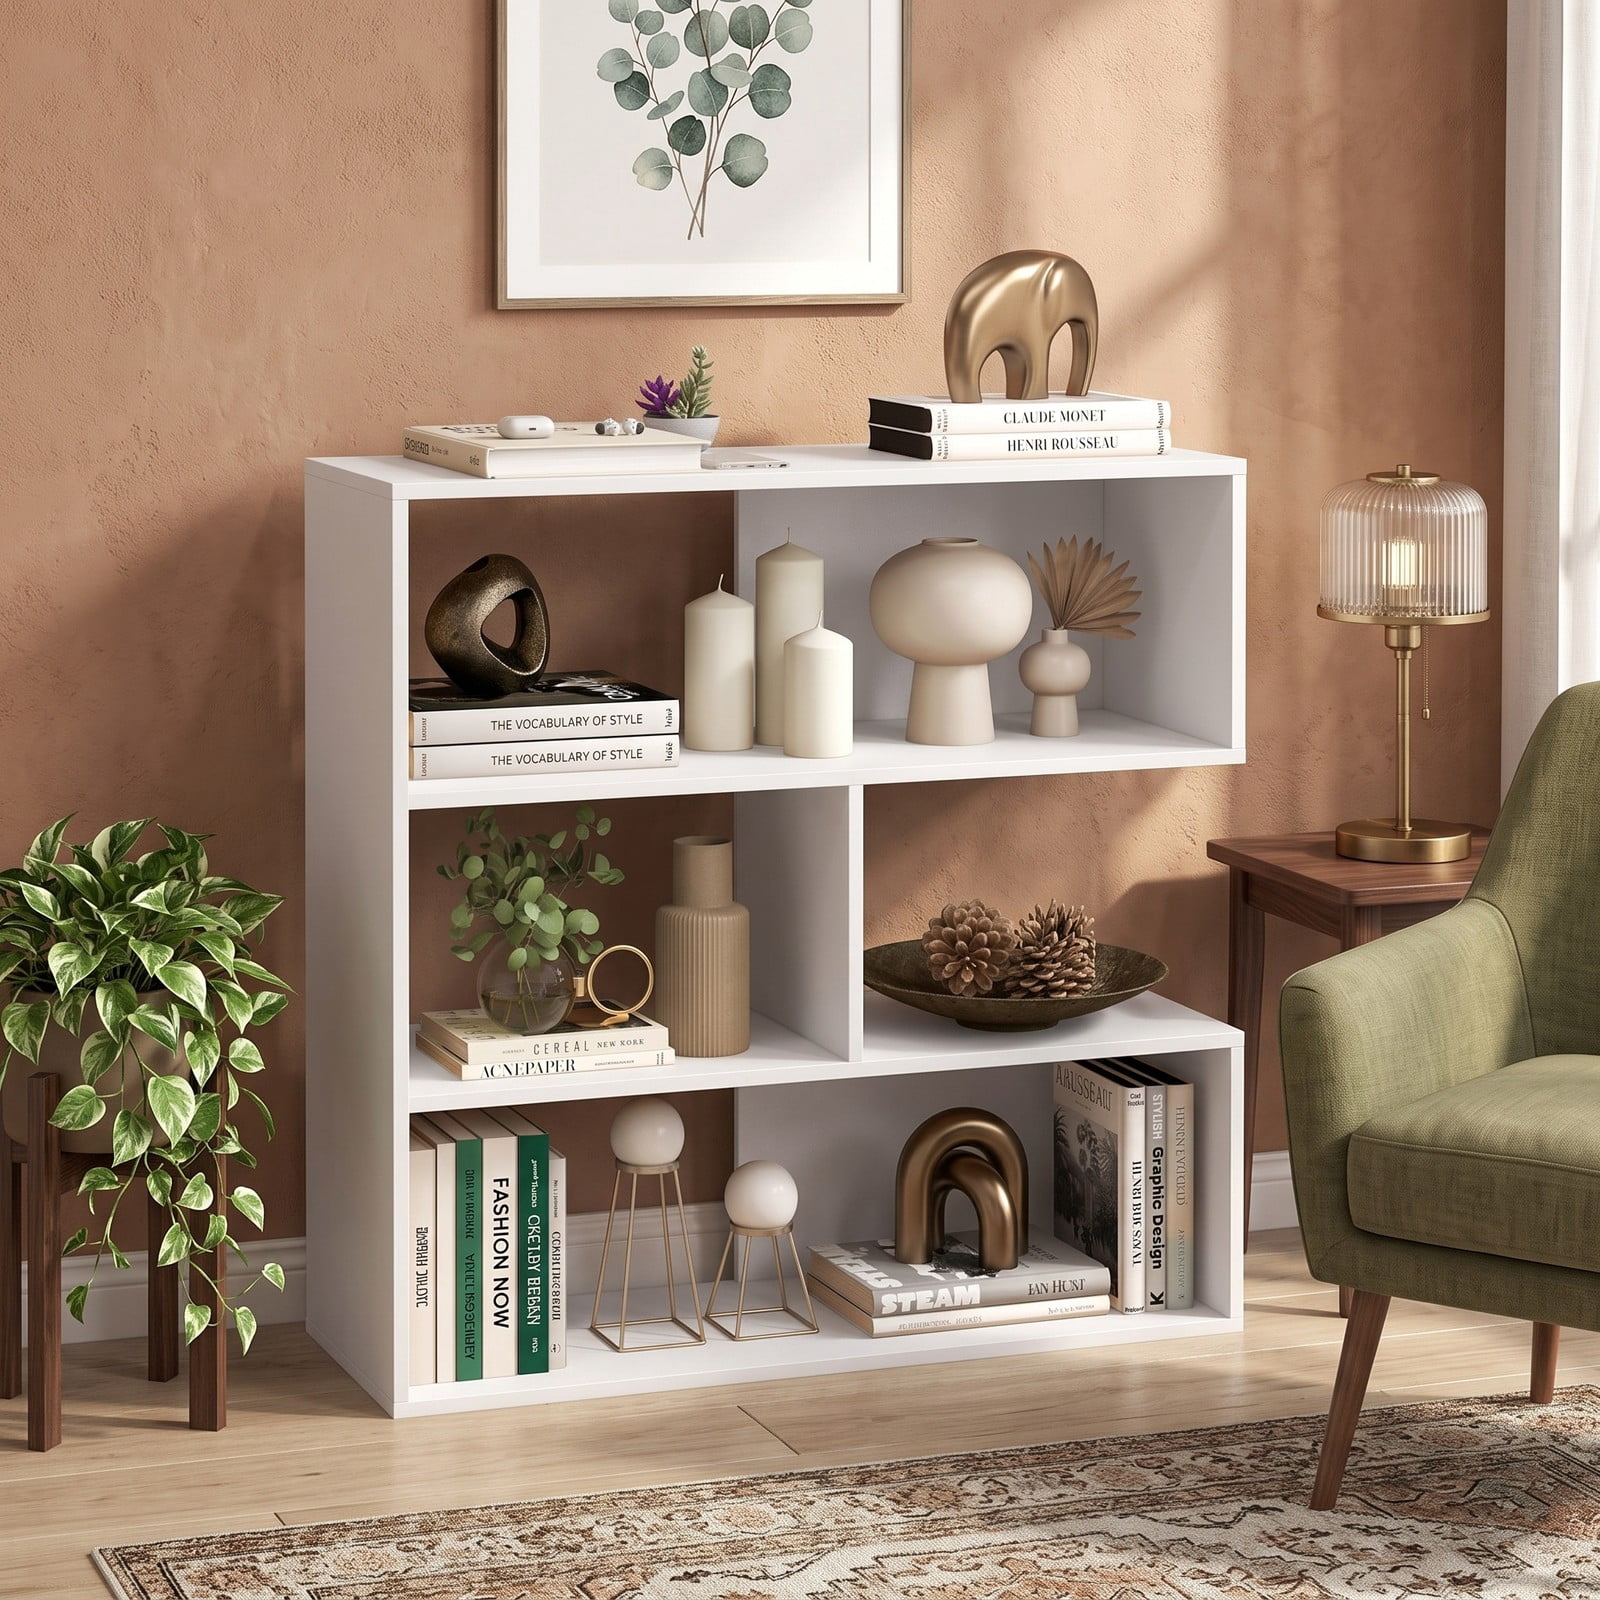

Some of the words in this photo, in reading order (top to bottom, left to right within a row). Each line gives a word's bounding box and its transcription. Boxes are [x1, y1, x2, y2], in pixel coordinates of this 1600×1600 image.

[1004, 409, 1057, 425] CLAUDE
[1059, 408, 1107, 423] MONET
[1007, 438, 1048, 452] HENRI
[1052, 435, 1119, 451] ROUSSEAU
[490, 719, 513, 731] THE
[516, 716, 590, 730] VOCABULARY
[592, 715, 607, 727] OF
[609, 713, 643, 726] STYLE
[490, 754, 513, 766] THE
[516, 751, 590, 765] VOCABULARY
[592, 750, 607, 762] OF
[609, 748, 643, 761] STYLE
[533, 1041, 590, 1056] CEREAL
[597, 1040, 616, 1049] NEW
[480, 1059, 576, 1079] ACNEPAPER
[1152, 1094, 1163, 1140] STYLISH
[1149, 1146, 1164, 1210] Graphic
[493, 1178, 510, 1270] FASHION
[1149, 1214, 1164, 1270] Design
[493, 1278, 510, 1329] NOW
[881, 1284, 981, 1315] STEAM
